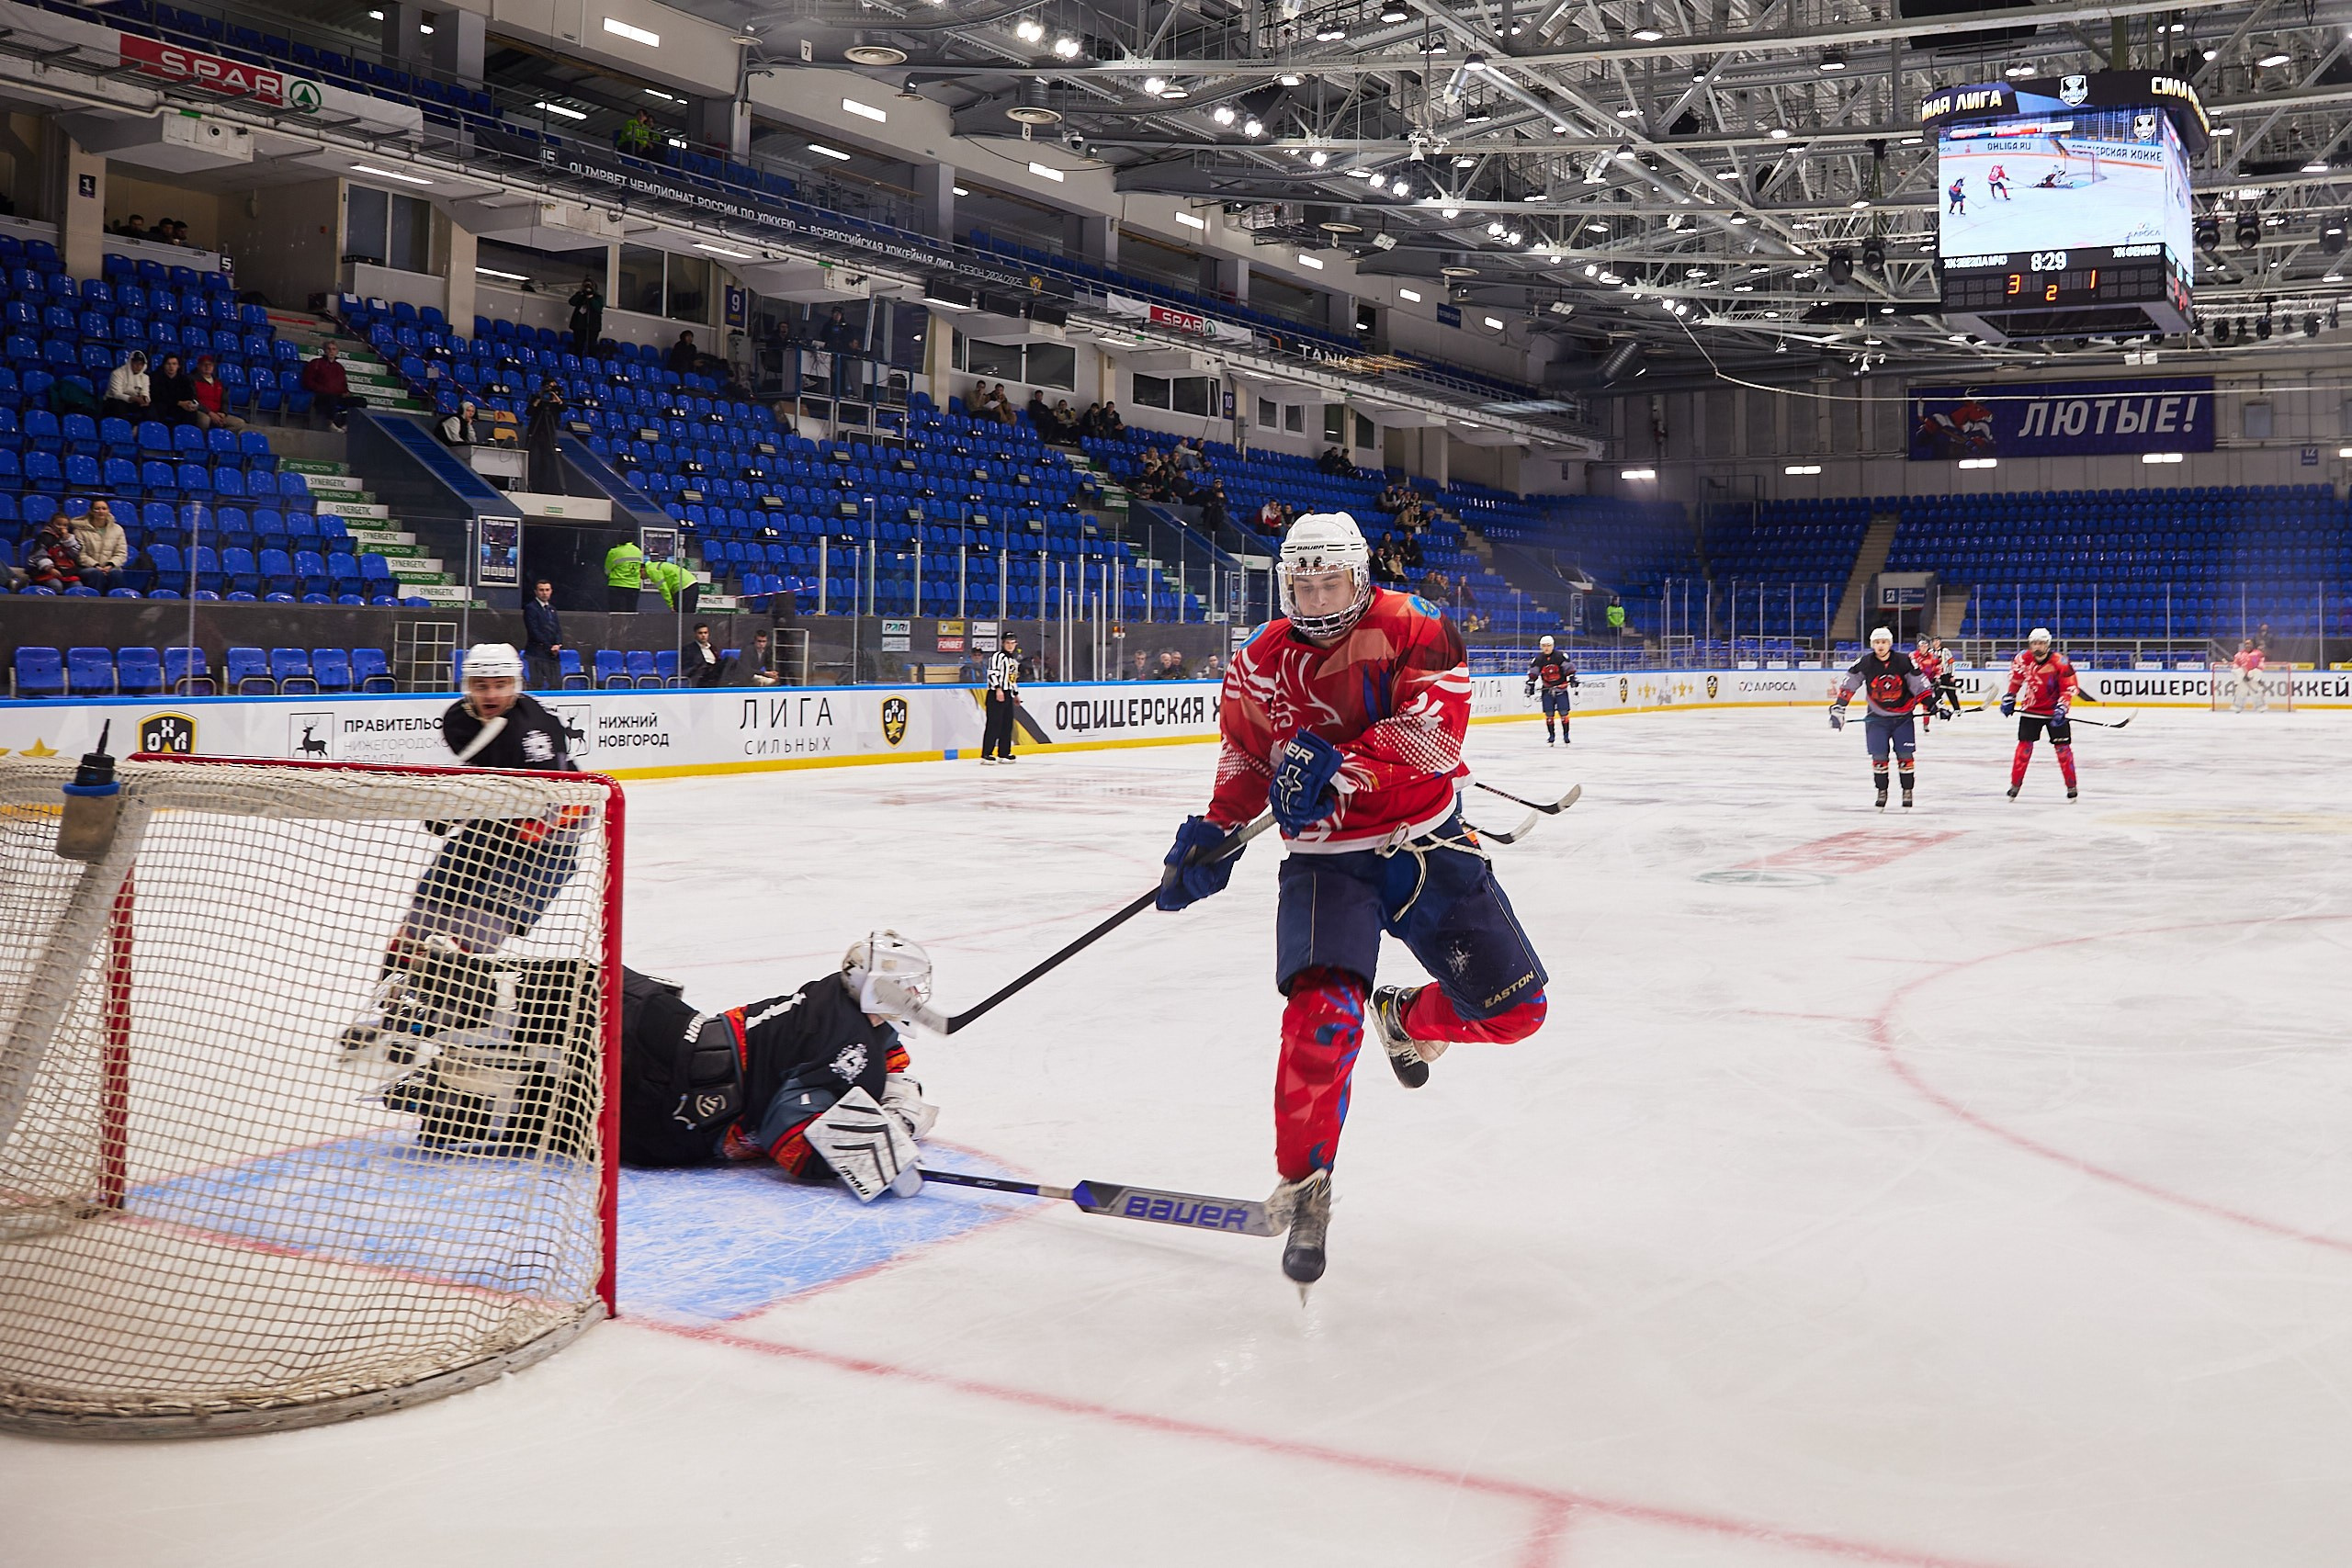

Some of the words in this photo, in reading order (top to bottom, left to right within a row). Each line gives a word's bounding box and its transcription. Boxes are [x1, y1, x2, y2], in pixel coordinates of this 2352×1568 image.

[161, 51, 279, 99] SPAR
[1955, 90, 2003, 111] ЛИГА
[82, 178, 92, 192] 1
[630, 177, 695, 203] ЧЕМПИОНАТ
[698, 196, 738, 215] РОССИИ
[741, 207, 755, 220] ПО
[758, 211, 796, 230] ХОККЕЮ
[810, 225, 884, 251] ВСЕРОССИЙСКАЯ
[935, 257, 955, 271] ЛИГА
[221, 257, 232, 270] 5
[2030, 251, 2067, 272] 8:29
[2007, 274, 2021, 294] 3
[2090, 269, 2097, 289] 1
[2045, 284, 2058, 301] 2
[731, 293, 741, 312] 9
[1162, 311, 1204, 332] SPAR
[1225, 395, 1233, 409] 10
[2018, 396, 2198, 437] ЛЮТЫЕ!
[311, 477, 346, 488] SYNERGETIC
[335, 504, 371, 515] SYNERGETIC
[362, 531, 398, 541] SYNERGETIC
[391, 559, 426, 569] SYNERGETIC
[419, 587, 455, 596] SYNERGETIC
[2100, 680, 2238, 697] ОФИЦЕРСКА
[2261, 676, 2349, 697] ХОККЕЙ
[599, 712, 658, 728] НИЖНИЙ
[740, 696, 833, 729] ЛИГА
[1056, 695, 1204, 732] ОФИЦЕРСКАЯ
[345, 717, 443, 733] ПРАВИТЕЛЬС
[344, 737, 449, 752] НИЖЕГОРОДСКО
[598, 733, 670, 748] НОВГОРОД
[744, 737, 831, 755] СИЛЬНЫХ
[1483, 970, 1535, 1010] EASTON
[1125, 1195, 1250, 1231] BAUER
